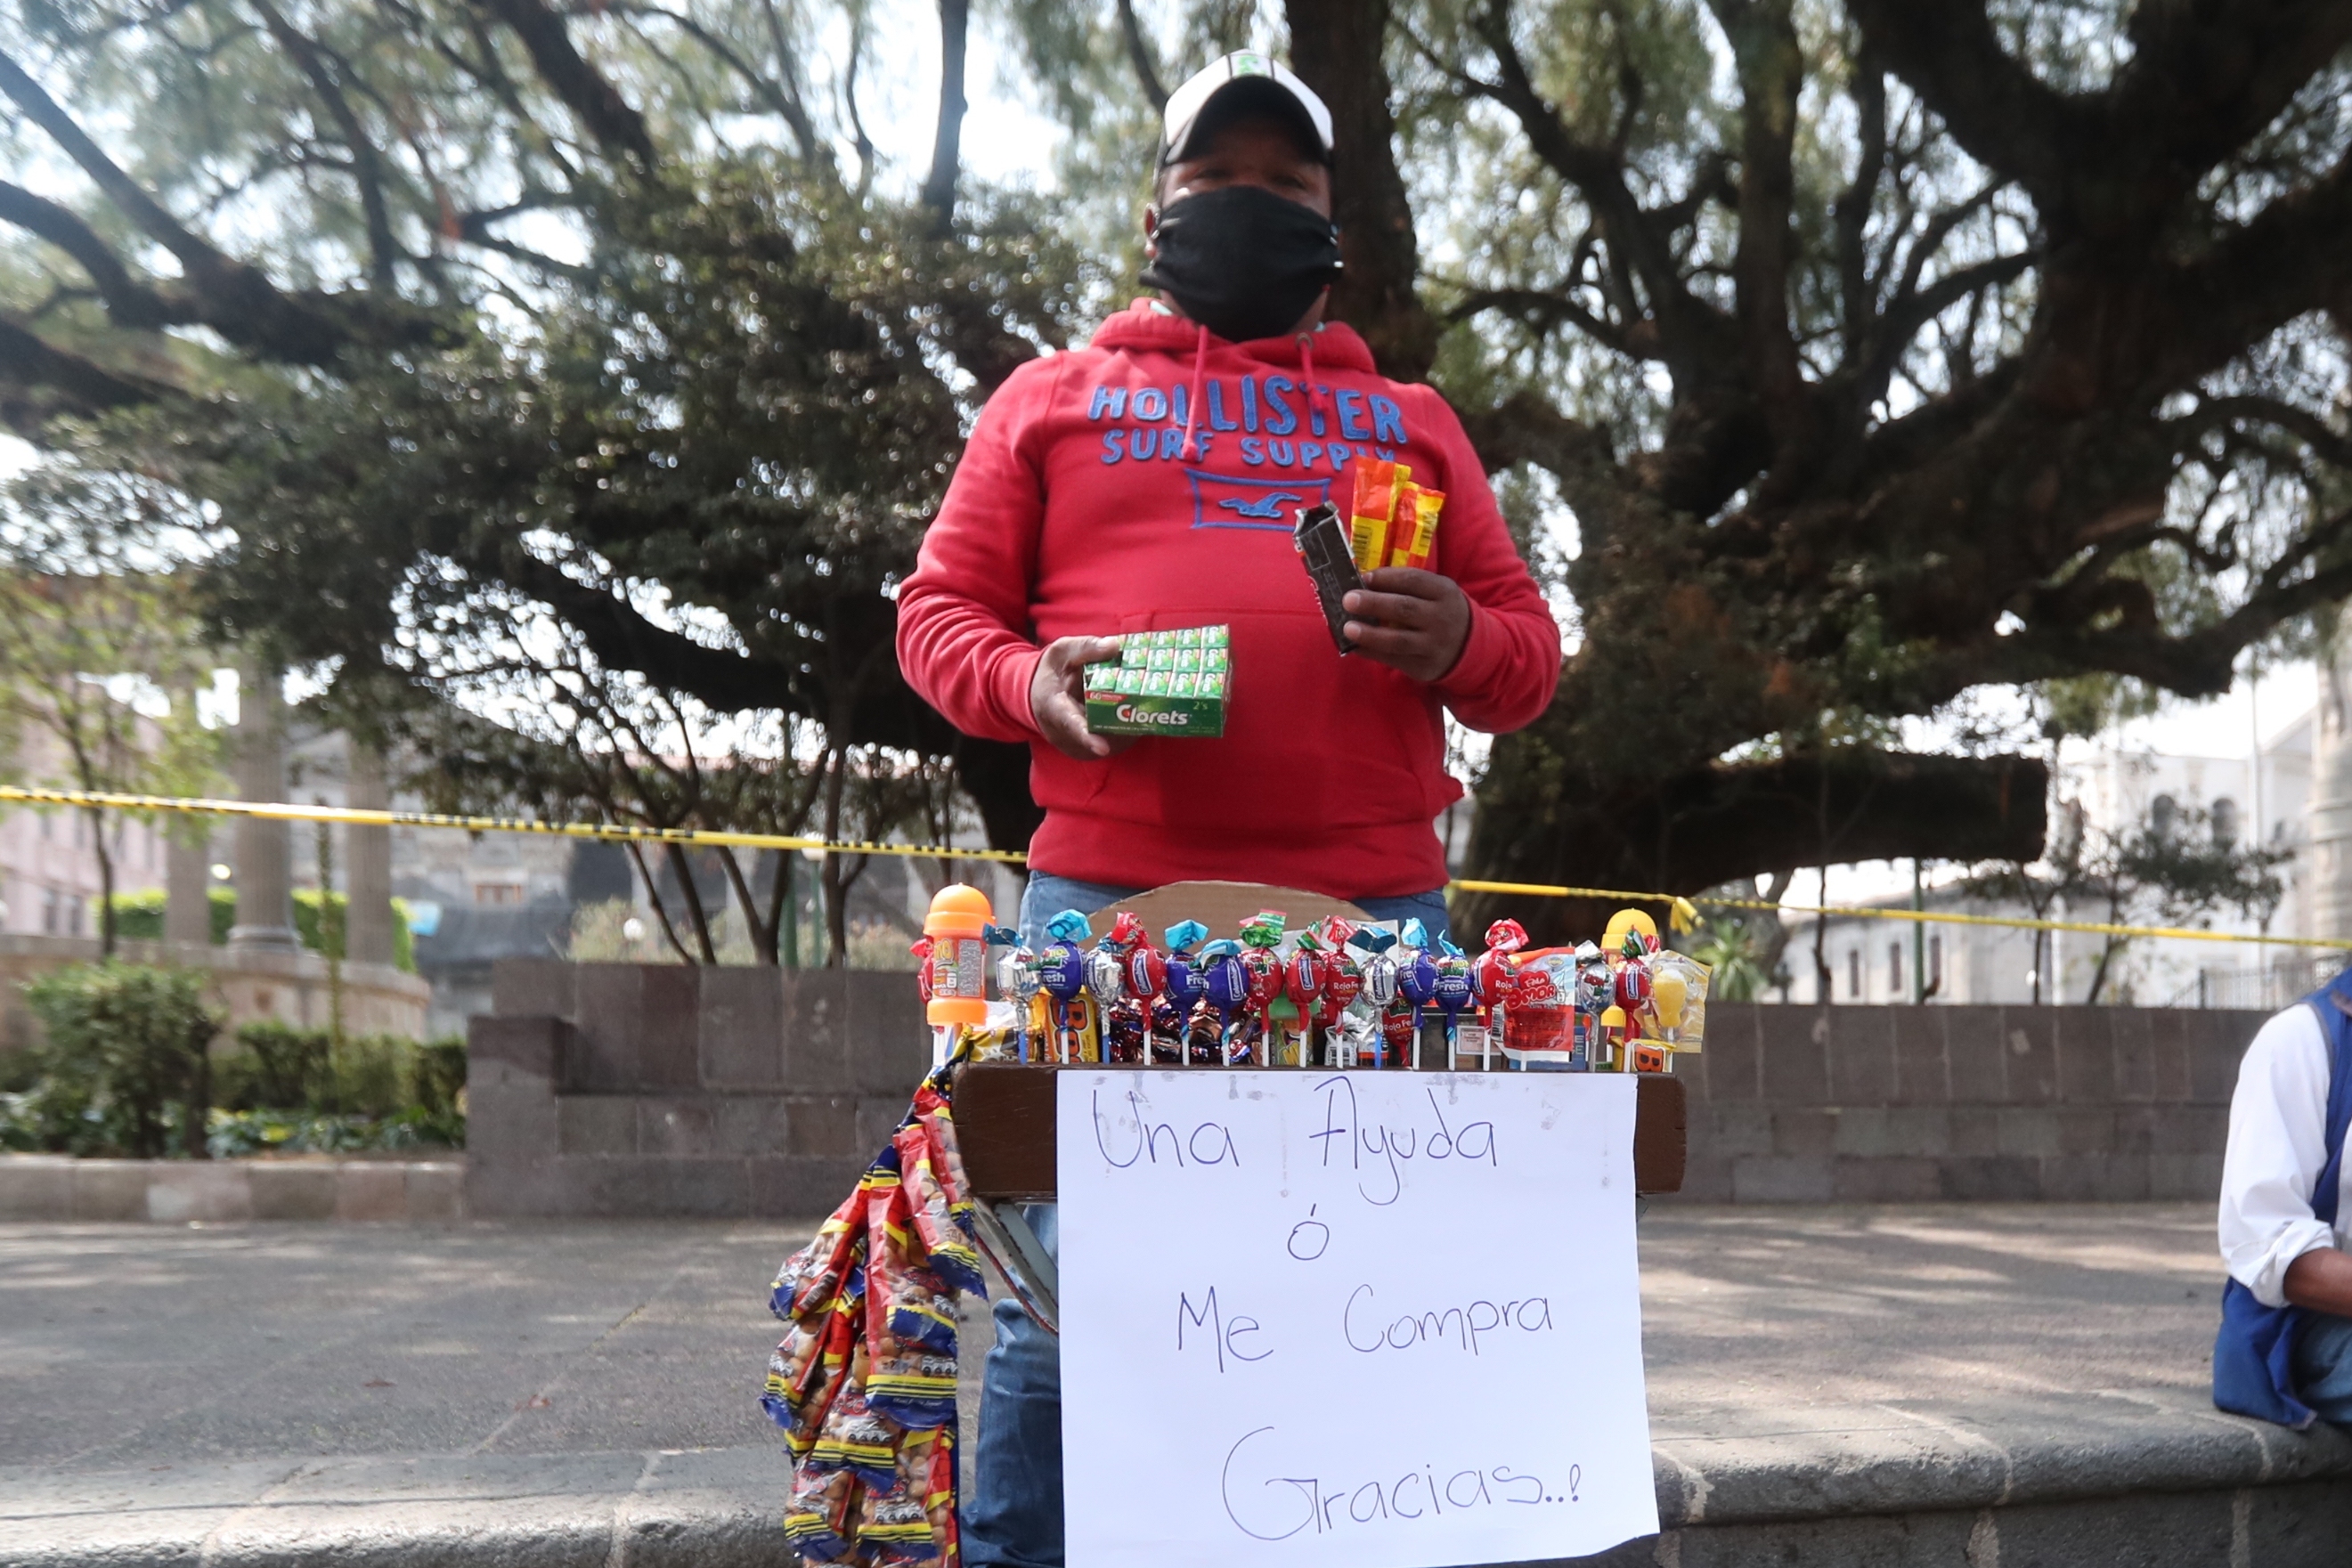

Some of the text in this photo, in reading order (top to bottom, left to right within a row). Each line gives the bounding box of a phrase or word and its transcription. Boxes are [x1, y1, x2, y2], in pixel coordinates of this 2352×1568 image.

[1087, 374, 1408, 444] HOLLISTER
[1101, 428, 1214, 464] SURF
[1116, 703, 1188, 725] Clorets
[1043, 972, 1065, 983] resh
[1094, 1076, 1497, 1206] Una Ayuda
[1177, 1283, 1553, 1374] Me Compra
